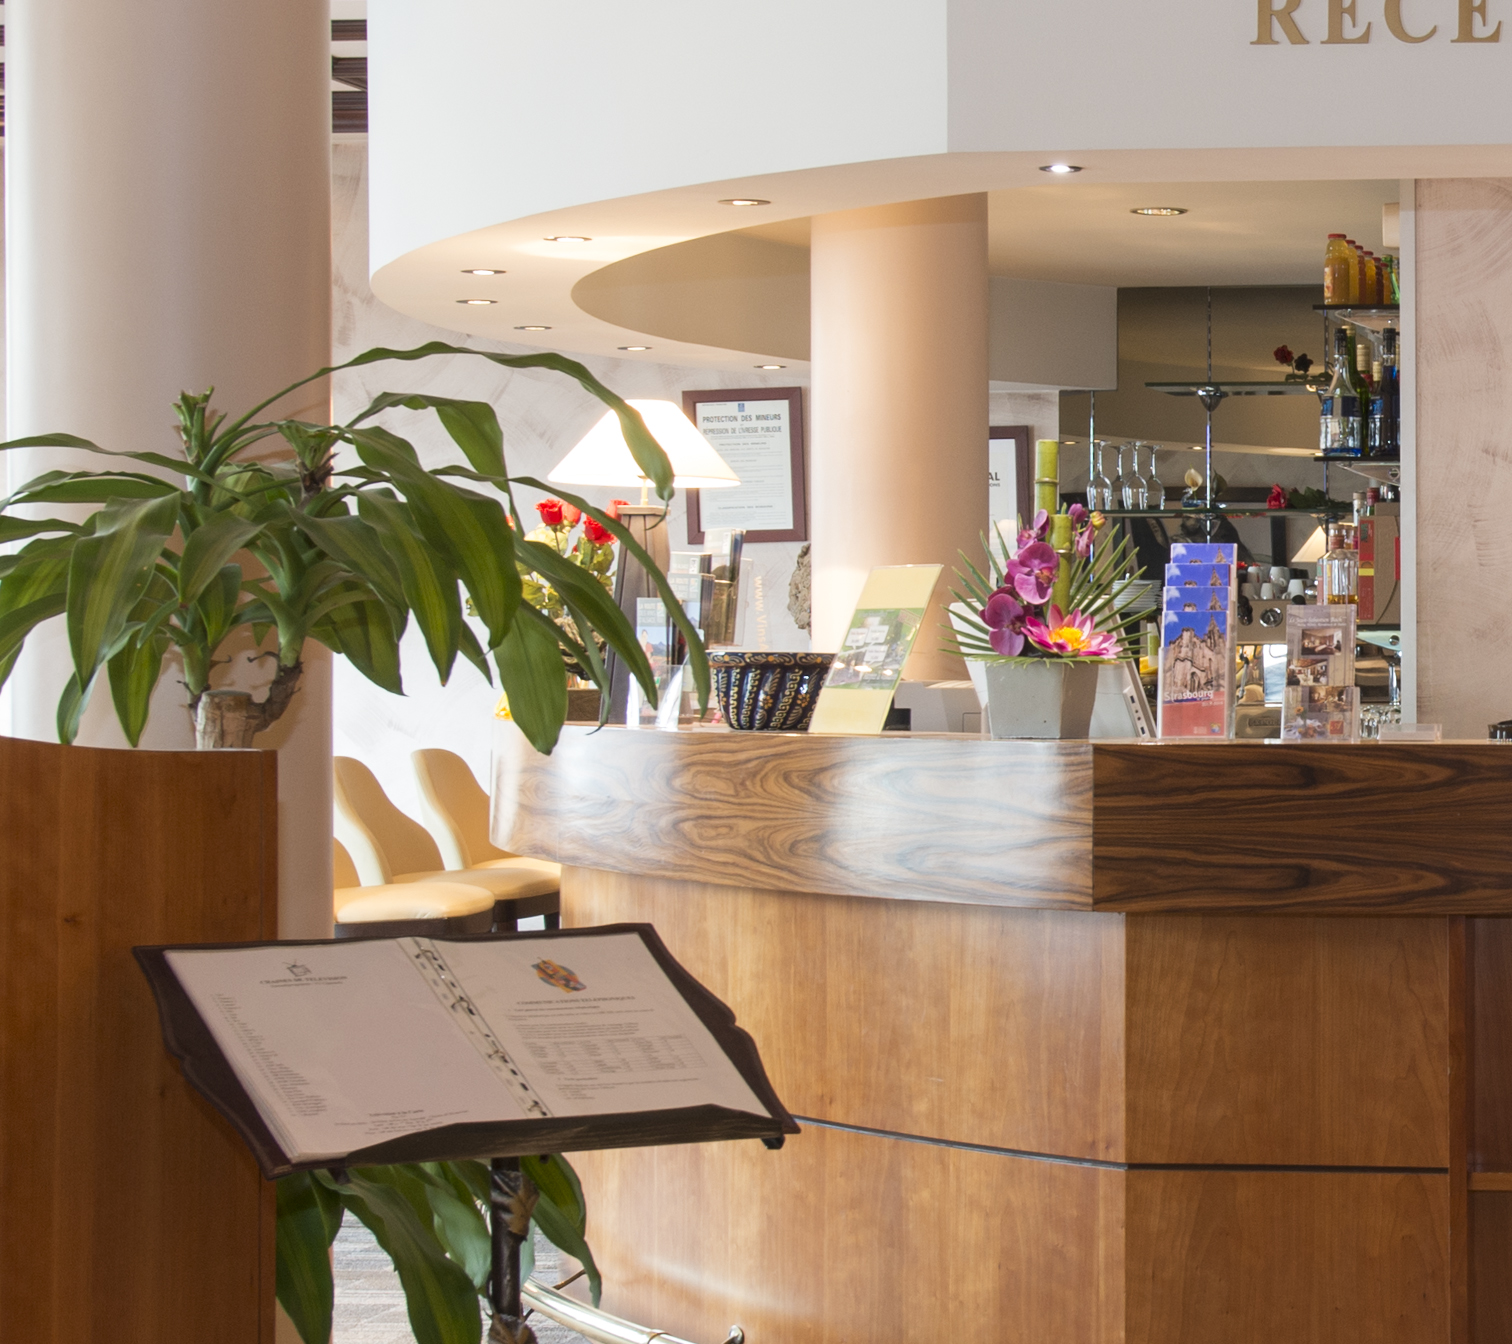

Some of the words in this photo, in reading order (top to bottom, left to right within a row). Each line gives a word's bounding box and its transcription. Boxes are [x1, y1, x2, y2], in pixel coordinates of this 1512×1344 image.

[702, 416, 738, 424] PROTECTION
[740, 414, 753, 422] DES
[755, 414, 782, 422] MINEURS
[1163, 688, 1214, 703] Strasbourg
